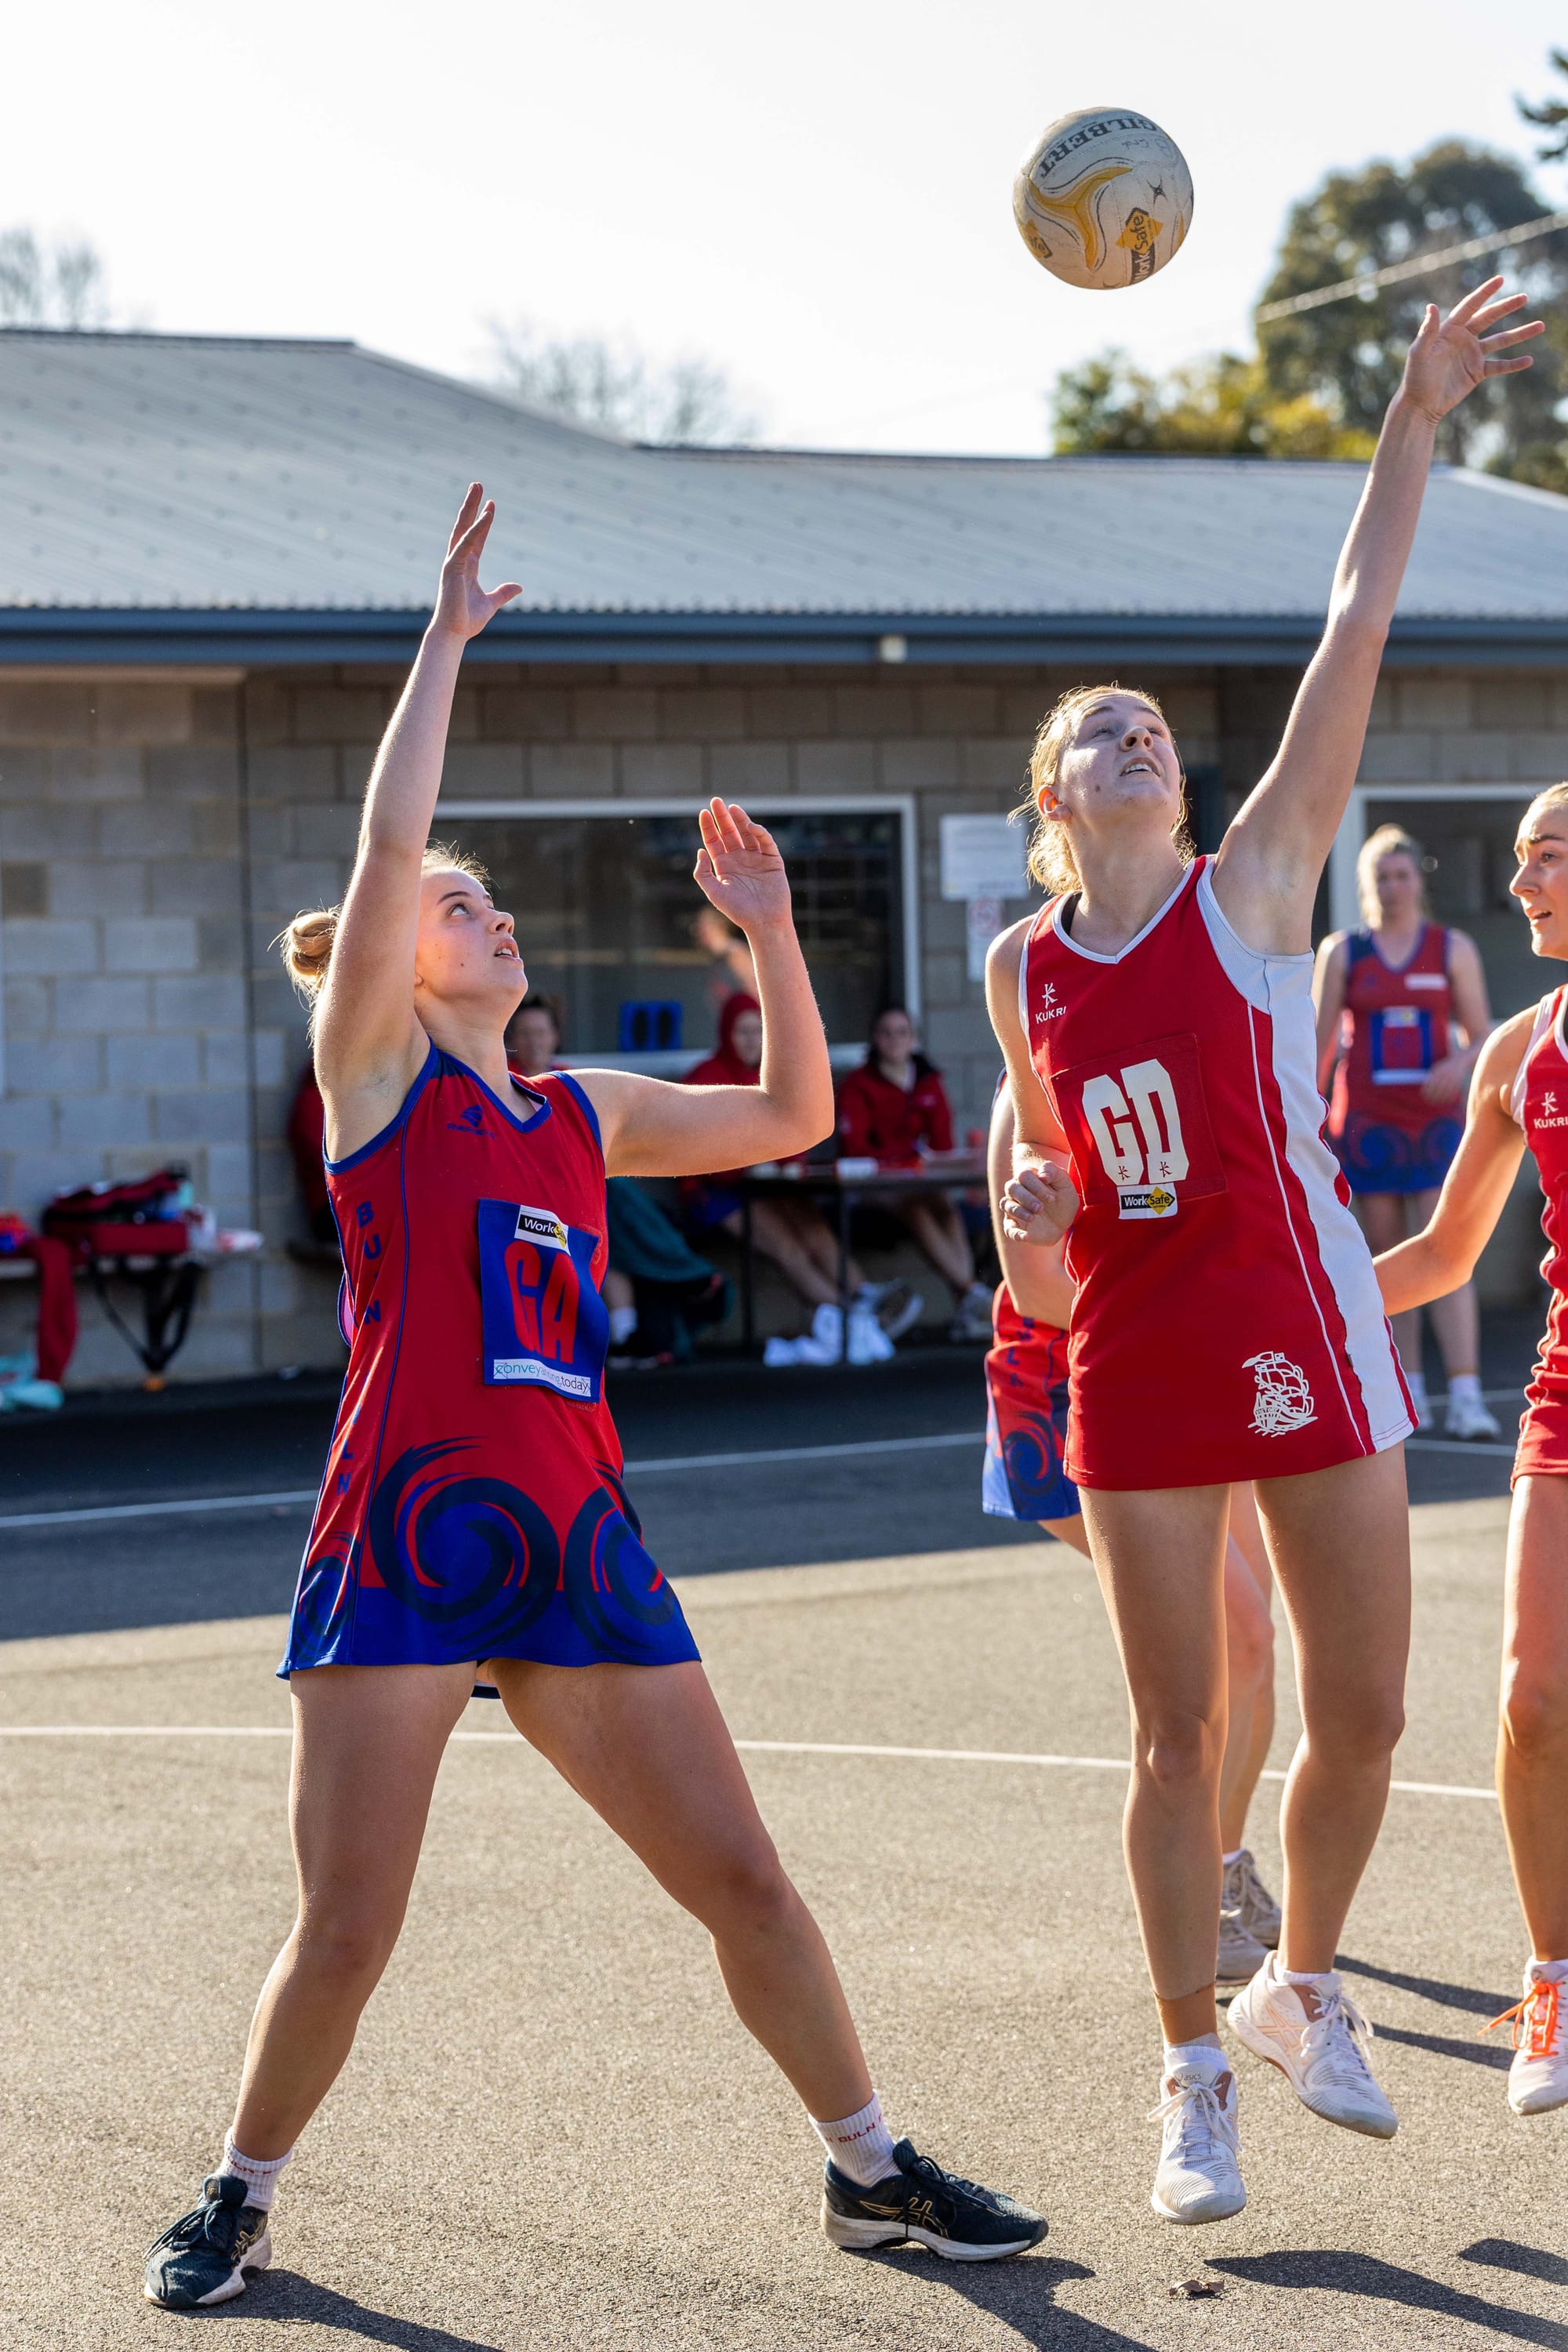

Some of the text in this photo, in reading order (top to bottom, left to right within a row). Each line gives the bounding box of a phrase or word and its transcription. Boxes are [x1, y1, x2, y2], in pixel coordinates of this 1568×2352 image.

[1039, 118, 1157, 177] GILBERT
[1035, 1005, 1067, 1024] KUKRI
[1082, 1058, 1189, 1186] GD
[1534, 1116, 1568, 1129] KUKRI
[356, 1201, 382, 1325] BUN
[504, 1240, 579, 1364] GA
